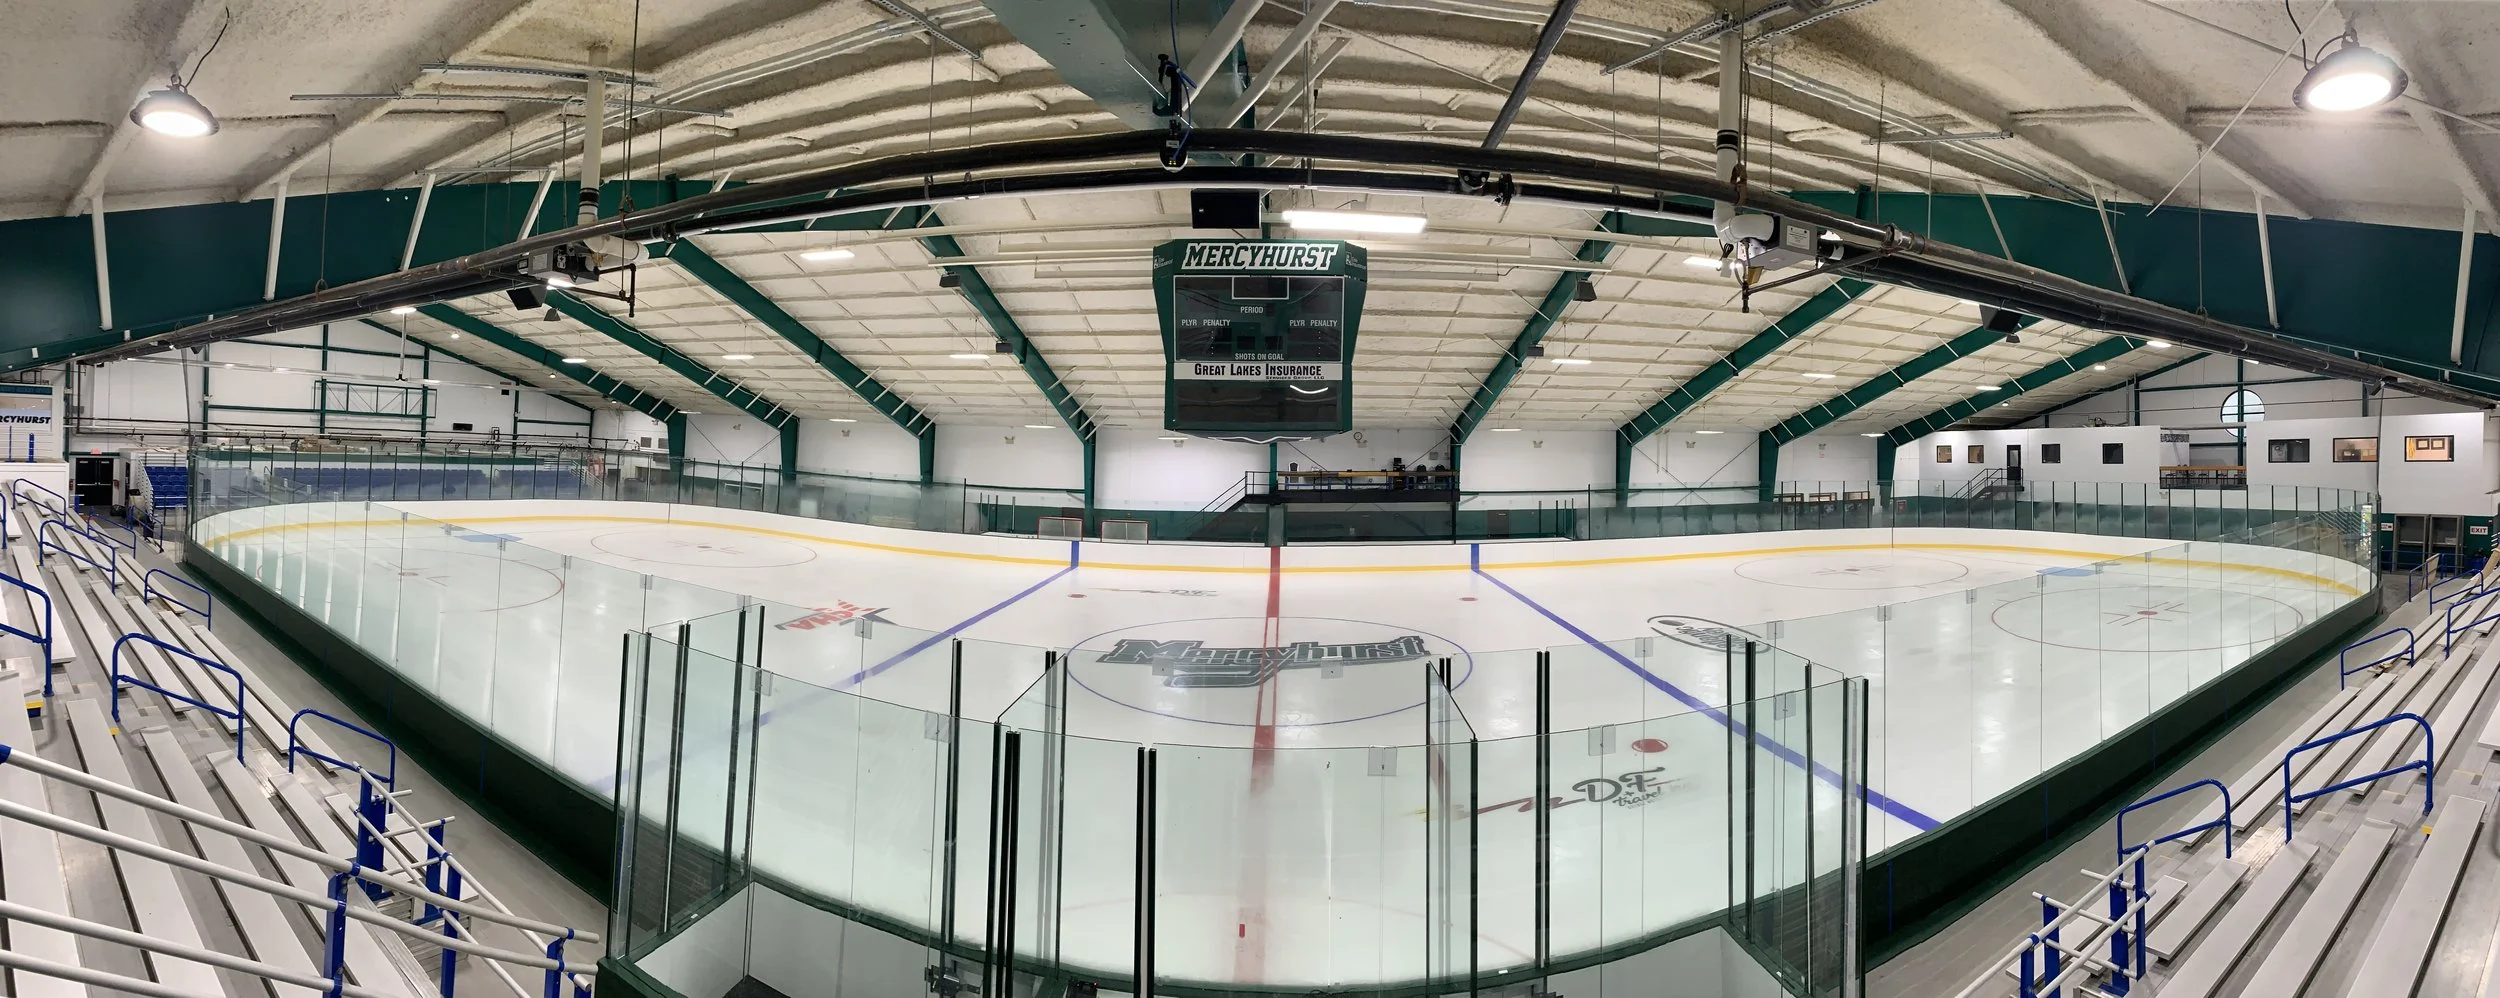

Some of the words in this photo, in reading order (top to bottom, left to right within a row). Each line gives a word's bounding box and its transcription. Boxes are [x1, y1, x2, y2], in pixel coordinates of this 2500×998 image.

[1182, 243, 1338, 270] MERCYHURST
[1240, 306, 1264, 314] PERIOD
[1194, 363, 1226, 376] GREAT
[1230, 363, 1262, 376] LAKES
[1265, 363, 1322, 376] INSURANCE
[1096, 636, 1431, 688] Mercyhurst
